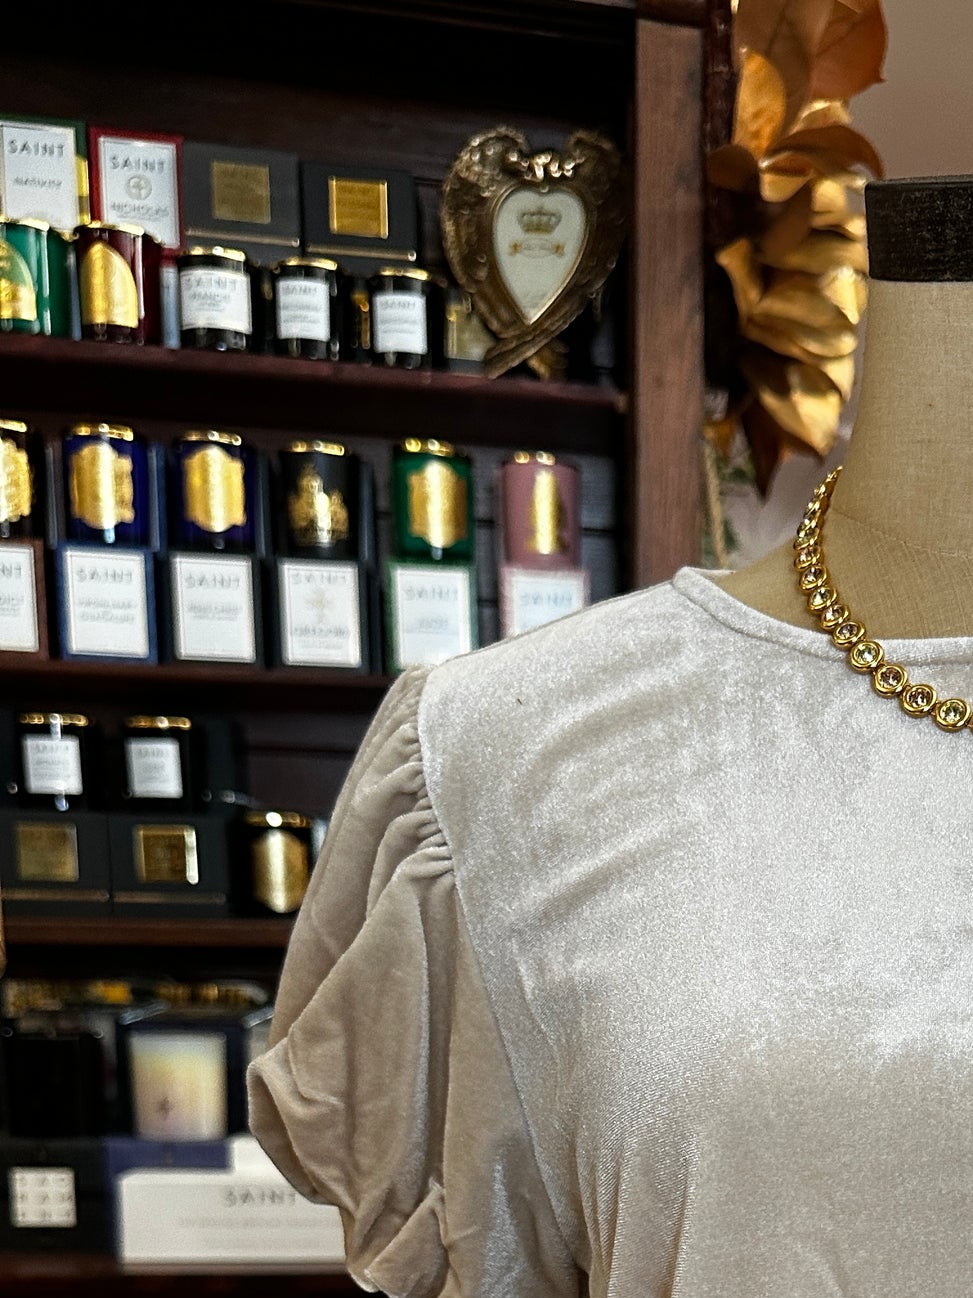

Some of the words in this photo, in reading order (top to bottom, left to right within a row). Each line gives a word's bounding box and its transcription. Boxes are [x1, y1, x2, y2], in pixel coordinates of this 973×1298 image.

[8, 139, 65, 158] SAINT
[110, 155, 166, 174] SAINT
[76, 567, 133, 585] SAINT
[185, 572, 241, 590] SAINT
[225, 1187, 297, 1208] SAINT
